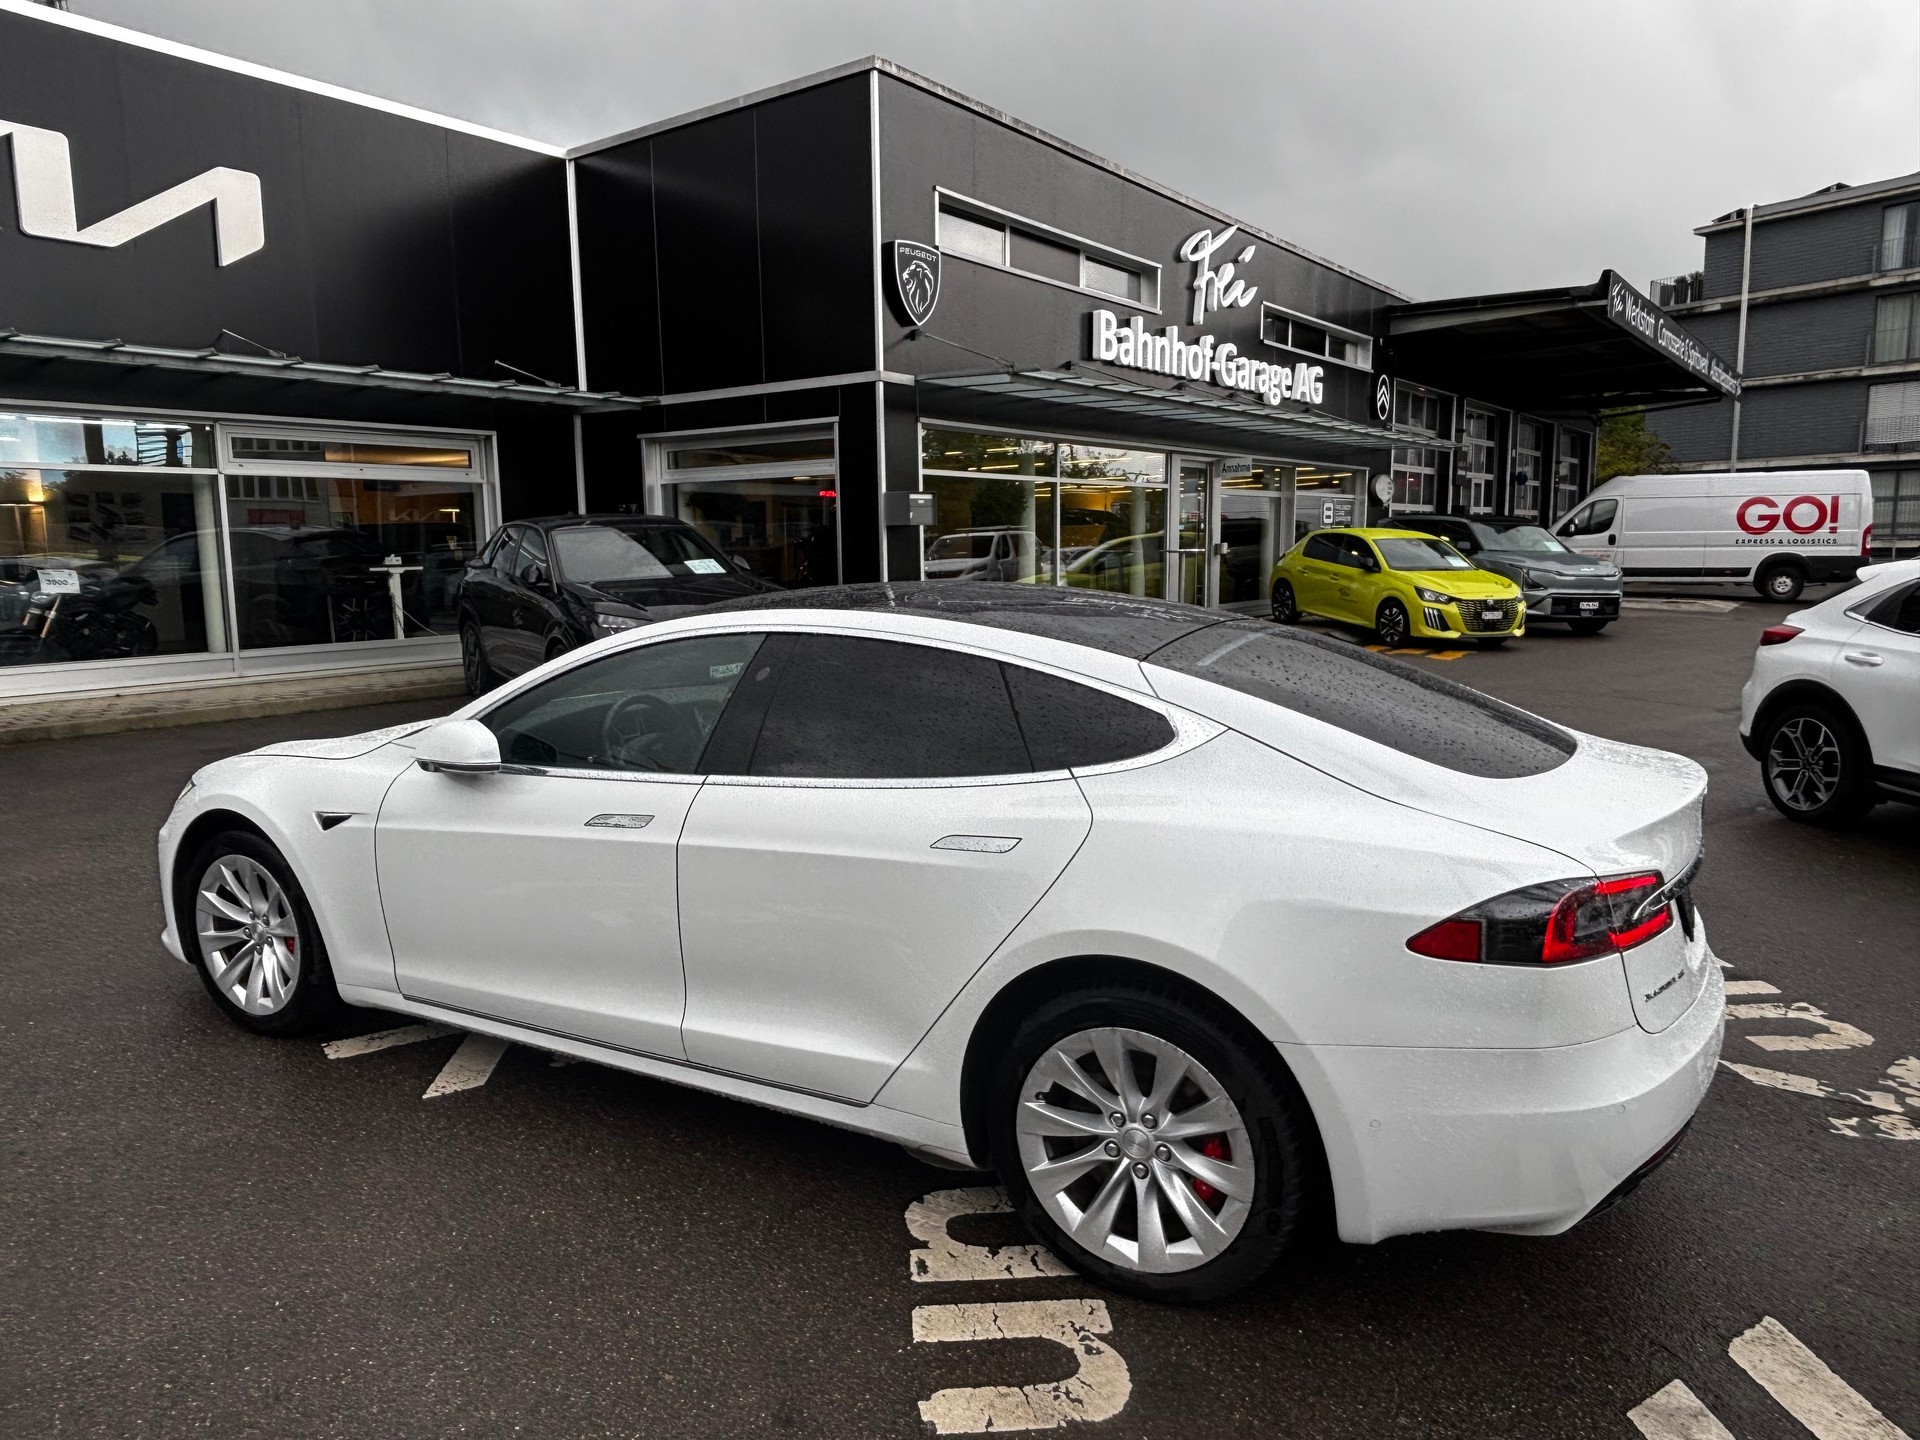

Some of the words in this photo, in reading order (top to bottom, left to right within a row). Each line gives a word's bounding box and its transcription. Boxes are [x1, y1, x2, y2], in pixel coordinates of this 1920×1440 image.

[899, 247, 937, 262] PEUGEOT
[1625, 291, 1655, 339] Werkstatt
[1093, 309, 1292, 405] Bahnhof-Garage
[1291, 362, 1324, 405] AG
[1221, 462, 1251, 474] Annahme
[1736, 495, 1840, 535] GO!
